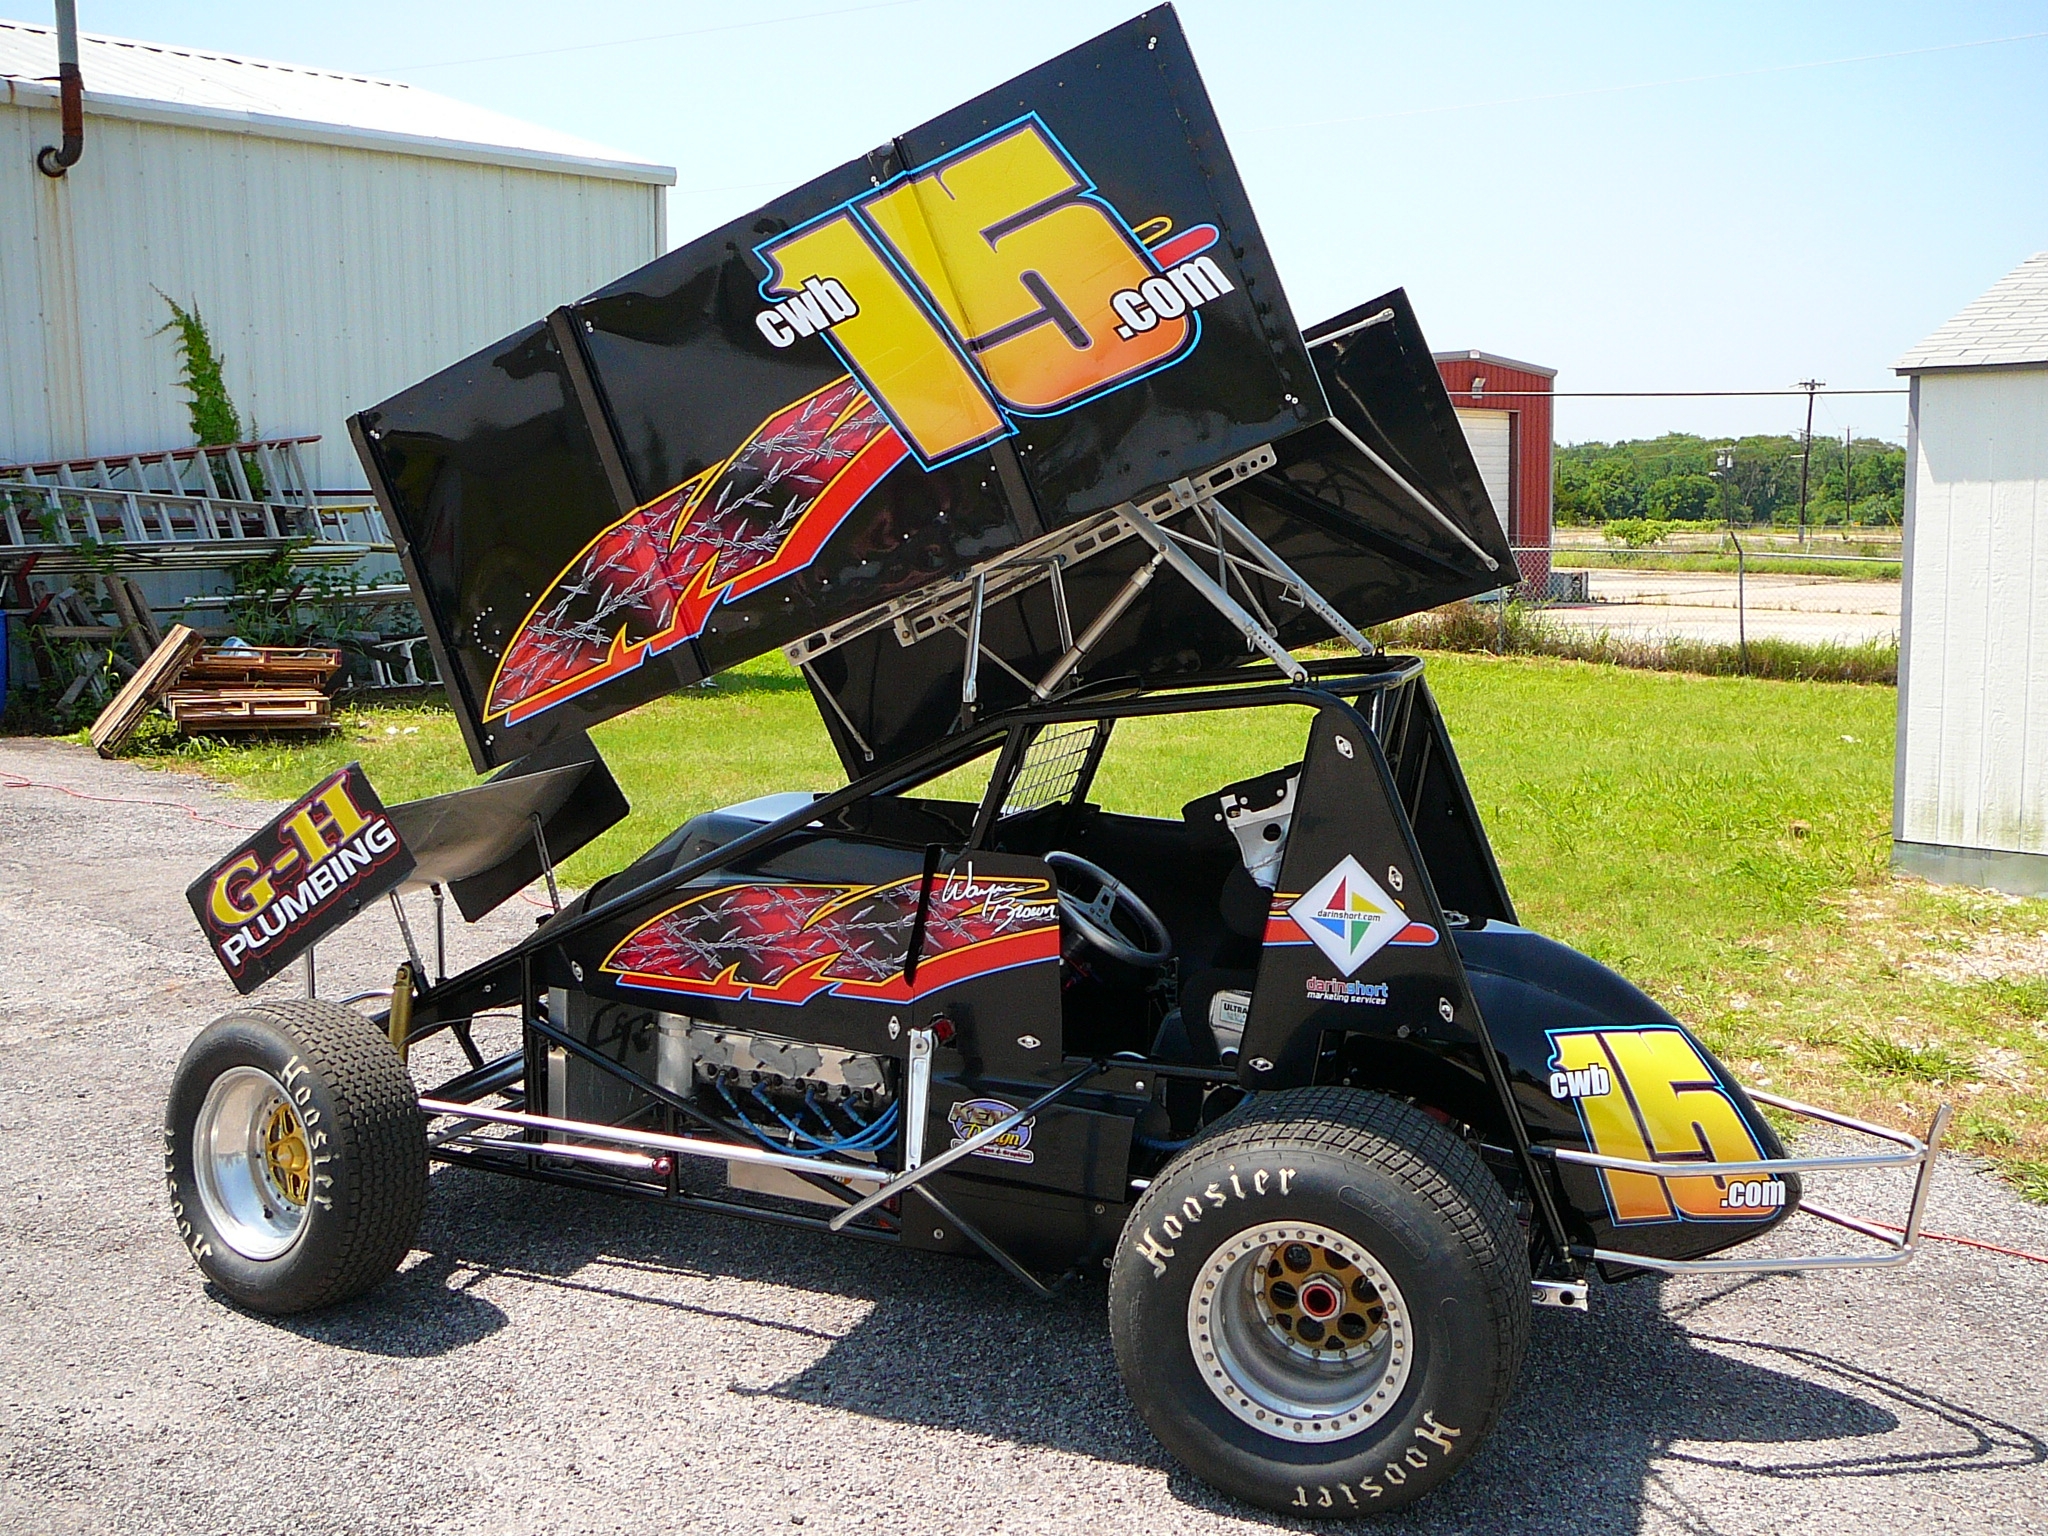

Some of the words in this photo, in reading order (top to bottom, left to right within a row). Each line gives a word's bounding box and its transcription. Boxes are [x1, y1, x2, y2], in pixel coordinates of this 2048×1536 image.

[754, 273, 860, 350] cwb
[758, 114, 1196, 470] 15
[1110, 255, 1236, 340] .com
[210, 774, 373, 926] G-H
[221, 818, 398, 968] PLUMBING
[984, 895, 1057, 936] Brown
[1317, 909, 1381, 922] darinshort.com
[1306, 976, 1389, 998] darinshort
[1307, 991, 1349, 1003] marketing
[1350, 995, 1387, 1005] services
[1550, 1064, 1612, 1099] cwb
[277, 1055, 339, 1211] Hoosier
[1547, 1026, 1781, 1225] 15
[1135, 1163, 1297, 1278] Hoosier
[1720, 1179, 1786, 1208] .com
[1291, 1409, 1461, 1509] Hoosier
